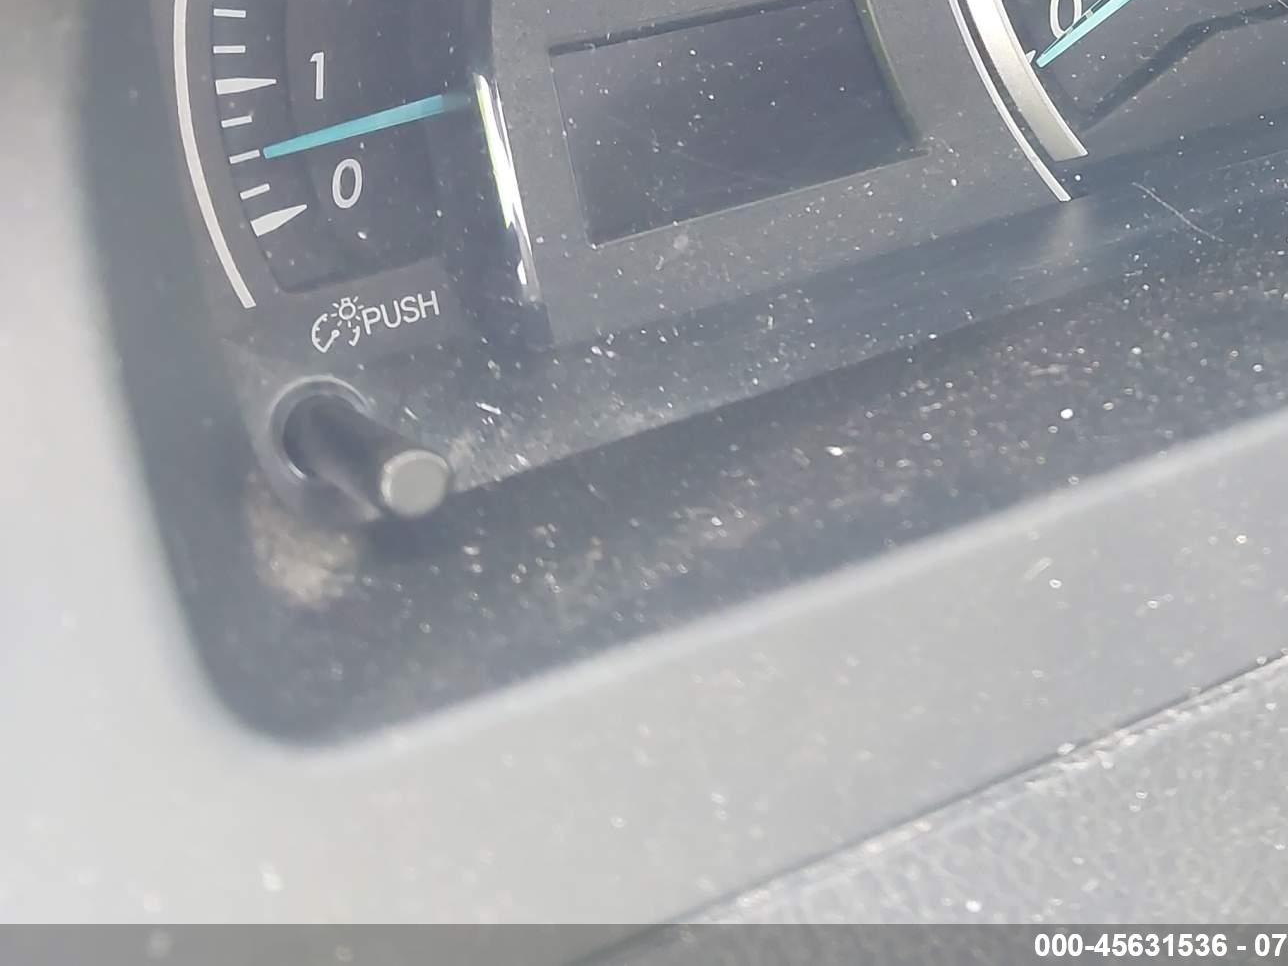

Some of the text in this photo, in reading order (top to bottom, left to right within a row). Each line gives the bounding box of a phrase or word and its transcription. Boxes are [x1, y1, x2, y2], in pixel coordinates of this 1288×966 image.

[309, 51, 325, 100] 1
[331, 158, 363, 209] 0
[361, 290, 440, 335] PUSH
